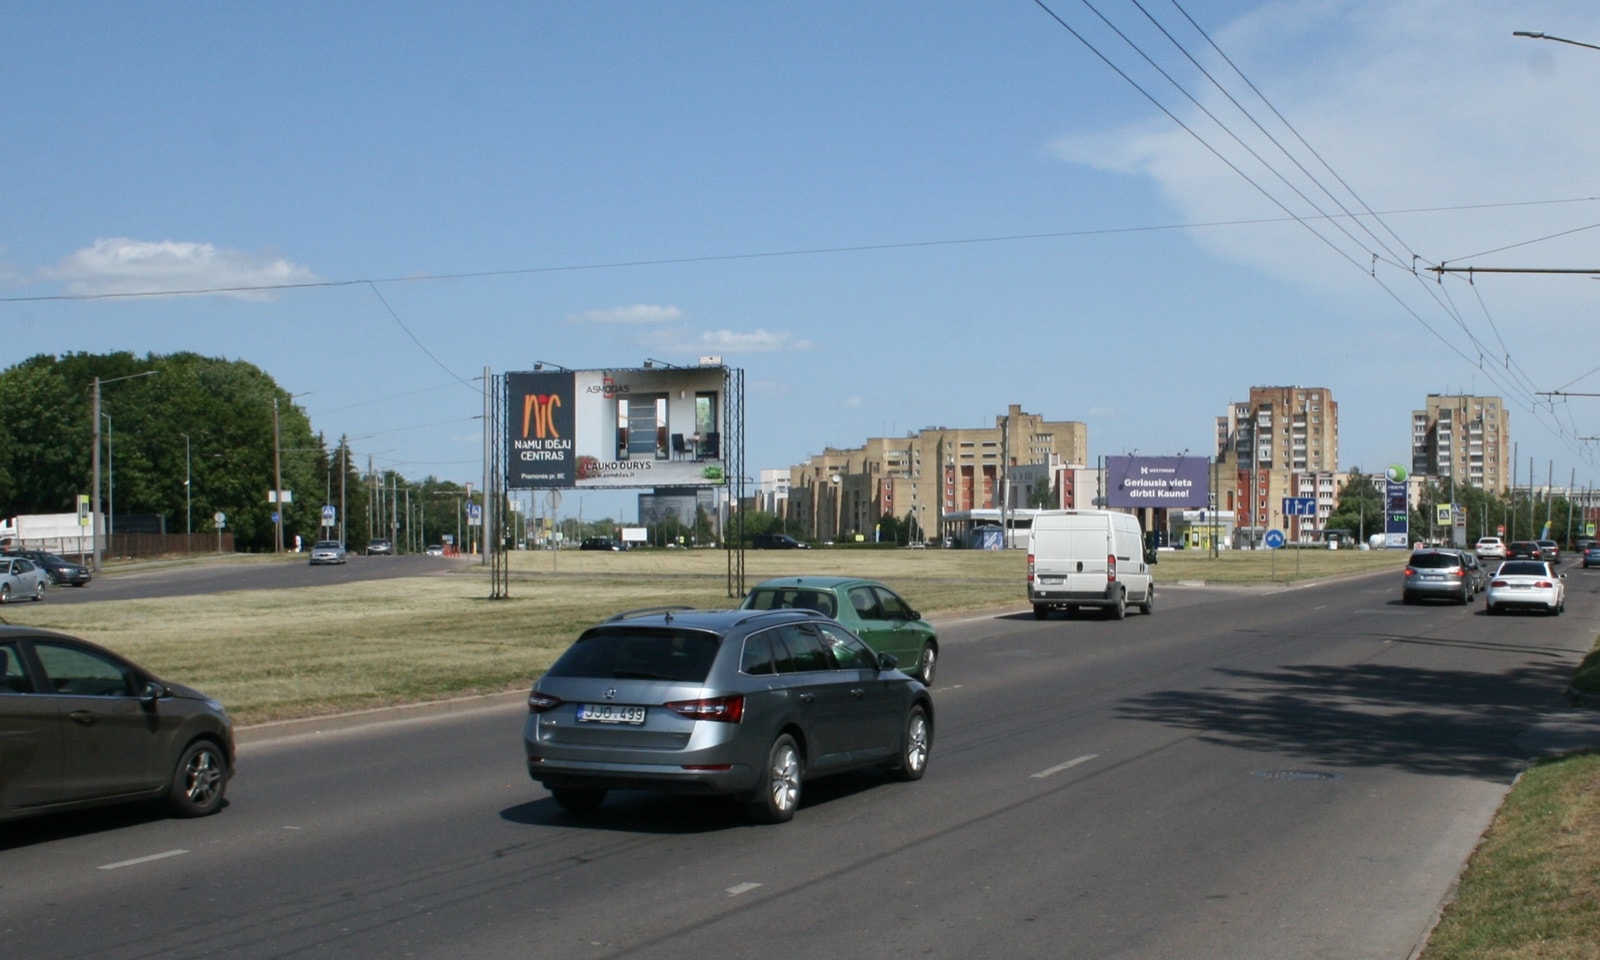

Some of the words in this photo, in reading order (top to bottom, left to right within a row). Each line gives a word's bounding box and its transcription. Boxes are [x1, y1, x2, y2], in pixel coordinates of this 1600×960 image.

[520, 451, 565, 461] CENTRAS
[586, 462, 618, 471] LAUKO
[1124, 478, 1167, 487] Geriausia
[1169, 478, 1193, 487] vieta
[1130, 489, 1156, 498] dirbti
[1157, 489, 1190, 498] Kaune!
[586, 706, 612, 718] JJO
[620, 708, 643, 720] 499
